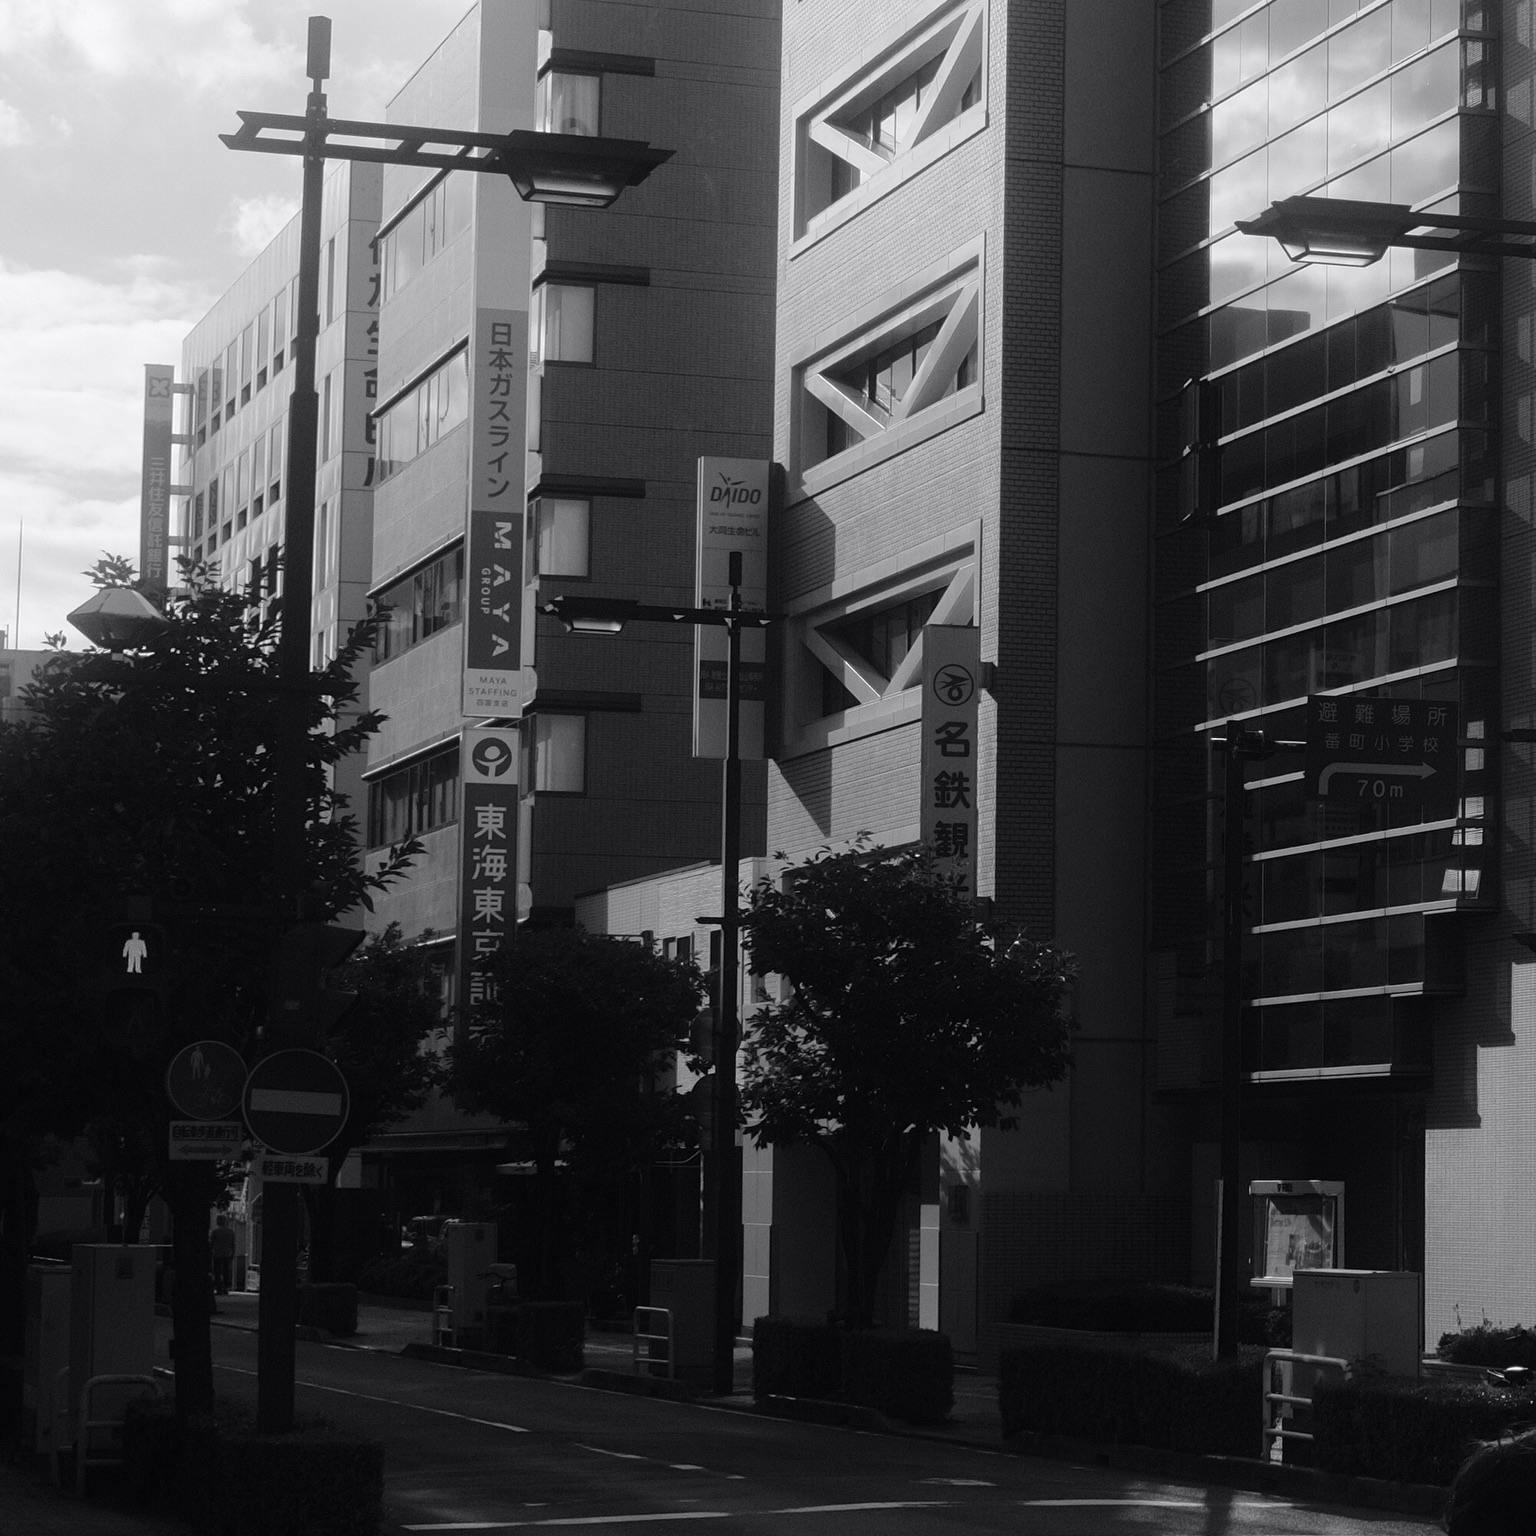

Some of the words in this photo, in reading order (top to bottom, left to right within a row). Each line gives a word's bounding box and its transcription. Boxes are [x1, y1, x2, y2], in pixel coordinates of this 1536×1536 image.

[487, 322, 514, 499] 日本ガスライン
[710, 484, 762, 509] DAIDO
[480, 567, 491, 615] GROUP
[491, 520, 513, 657] MAYA
[468, 688, 518, 697] STAFFING
[479, 676, 508, 685] MAYA
[1318, 701, 1449, 728] 避難場所
[1324, 732, 1441, 753] 番町小学校
[1356, 779, 1404, 798] 70m
